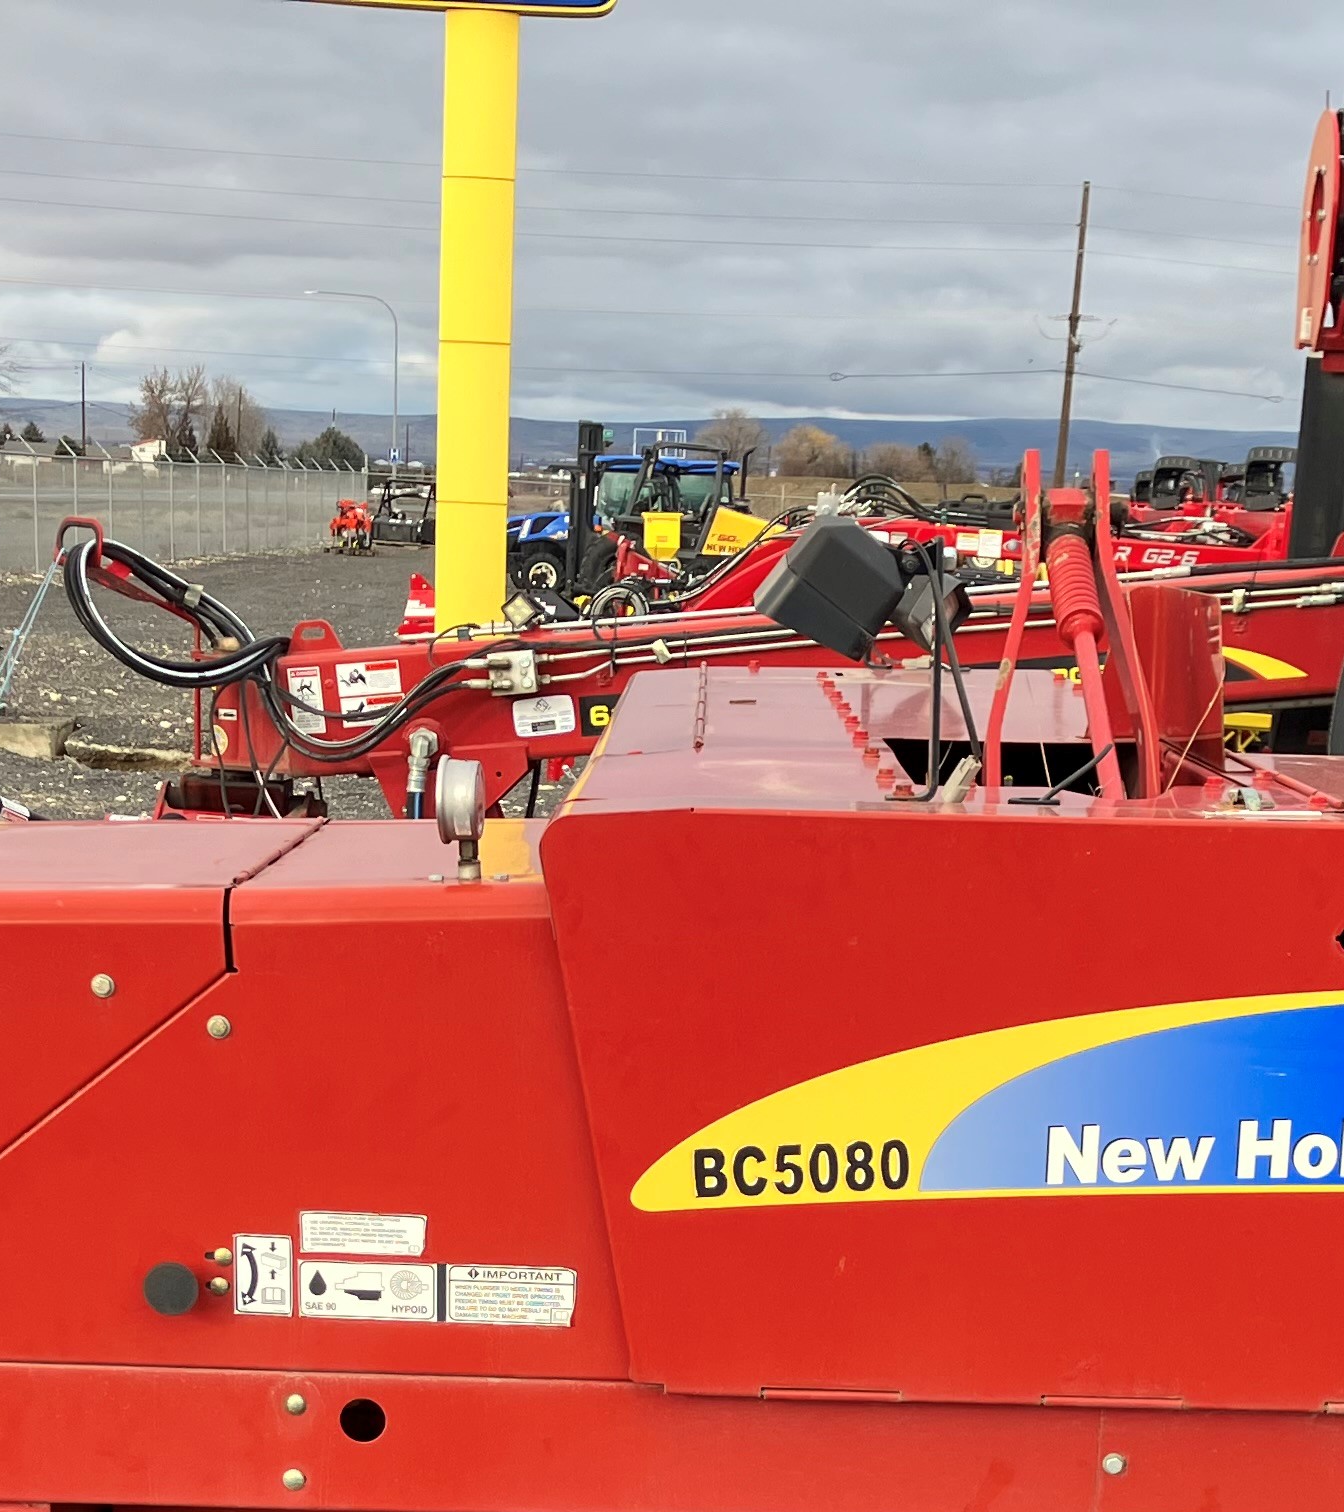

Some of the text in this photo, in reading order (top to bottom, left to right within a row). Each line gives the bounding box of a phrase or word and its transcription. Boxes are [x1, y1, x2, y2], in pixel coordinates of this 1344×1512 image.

[1142, 547, 1200, 567] G2-6
[1046, 1125, 1222, 1185] New
[692, 1139, 910, 1199] BC5080
[482, 1269, 562, 1281] IMPORTANT
[304, 1301, 337, 1310] SAE 90
[391, 1305, 428, 1314] HYPOID
